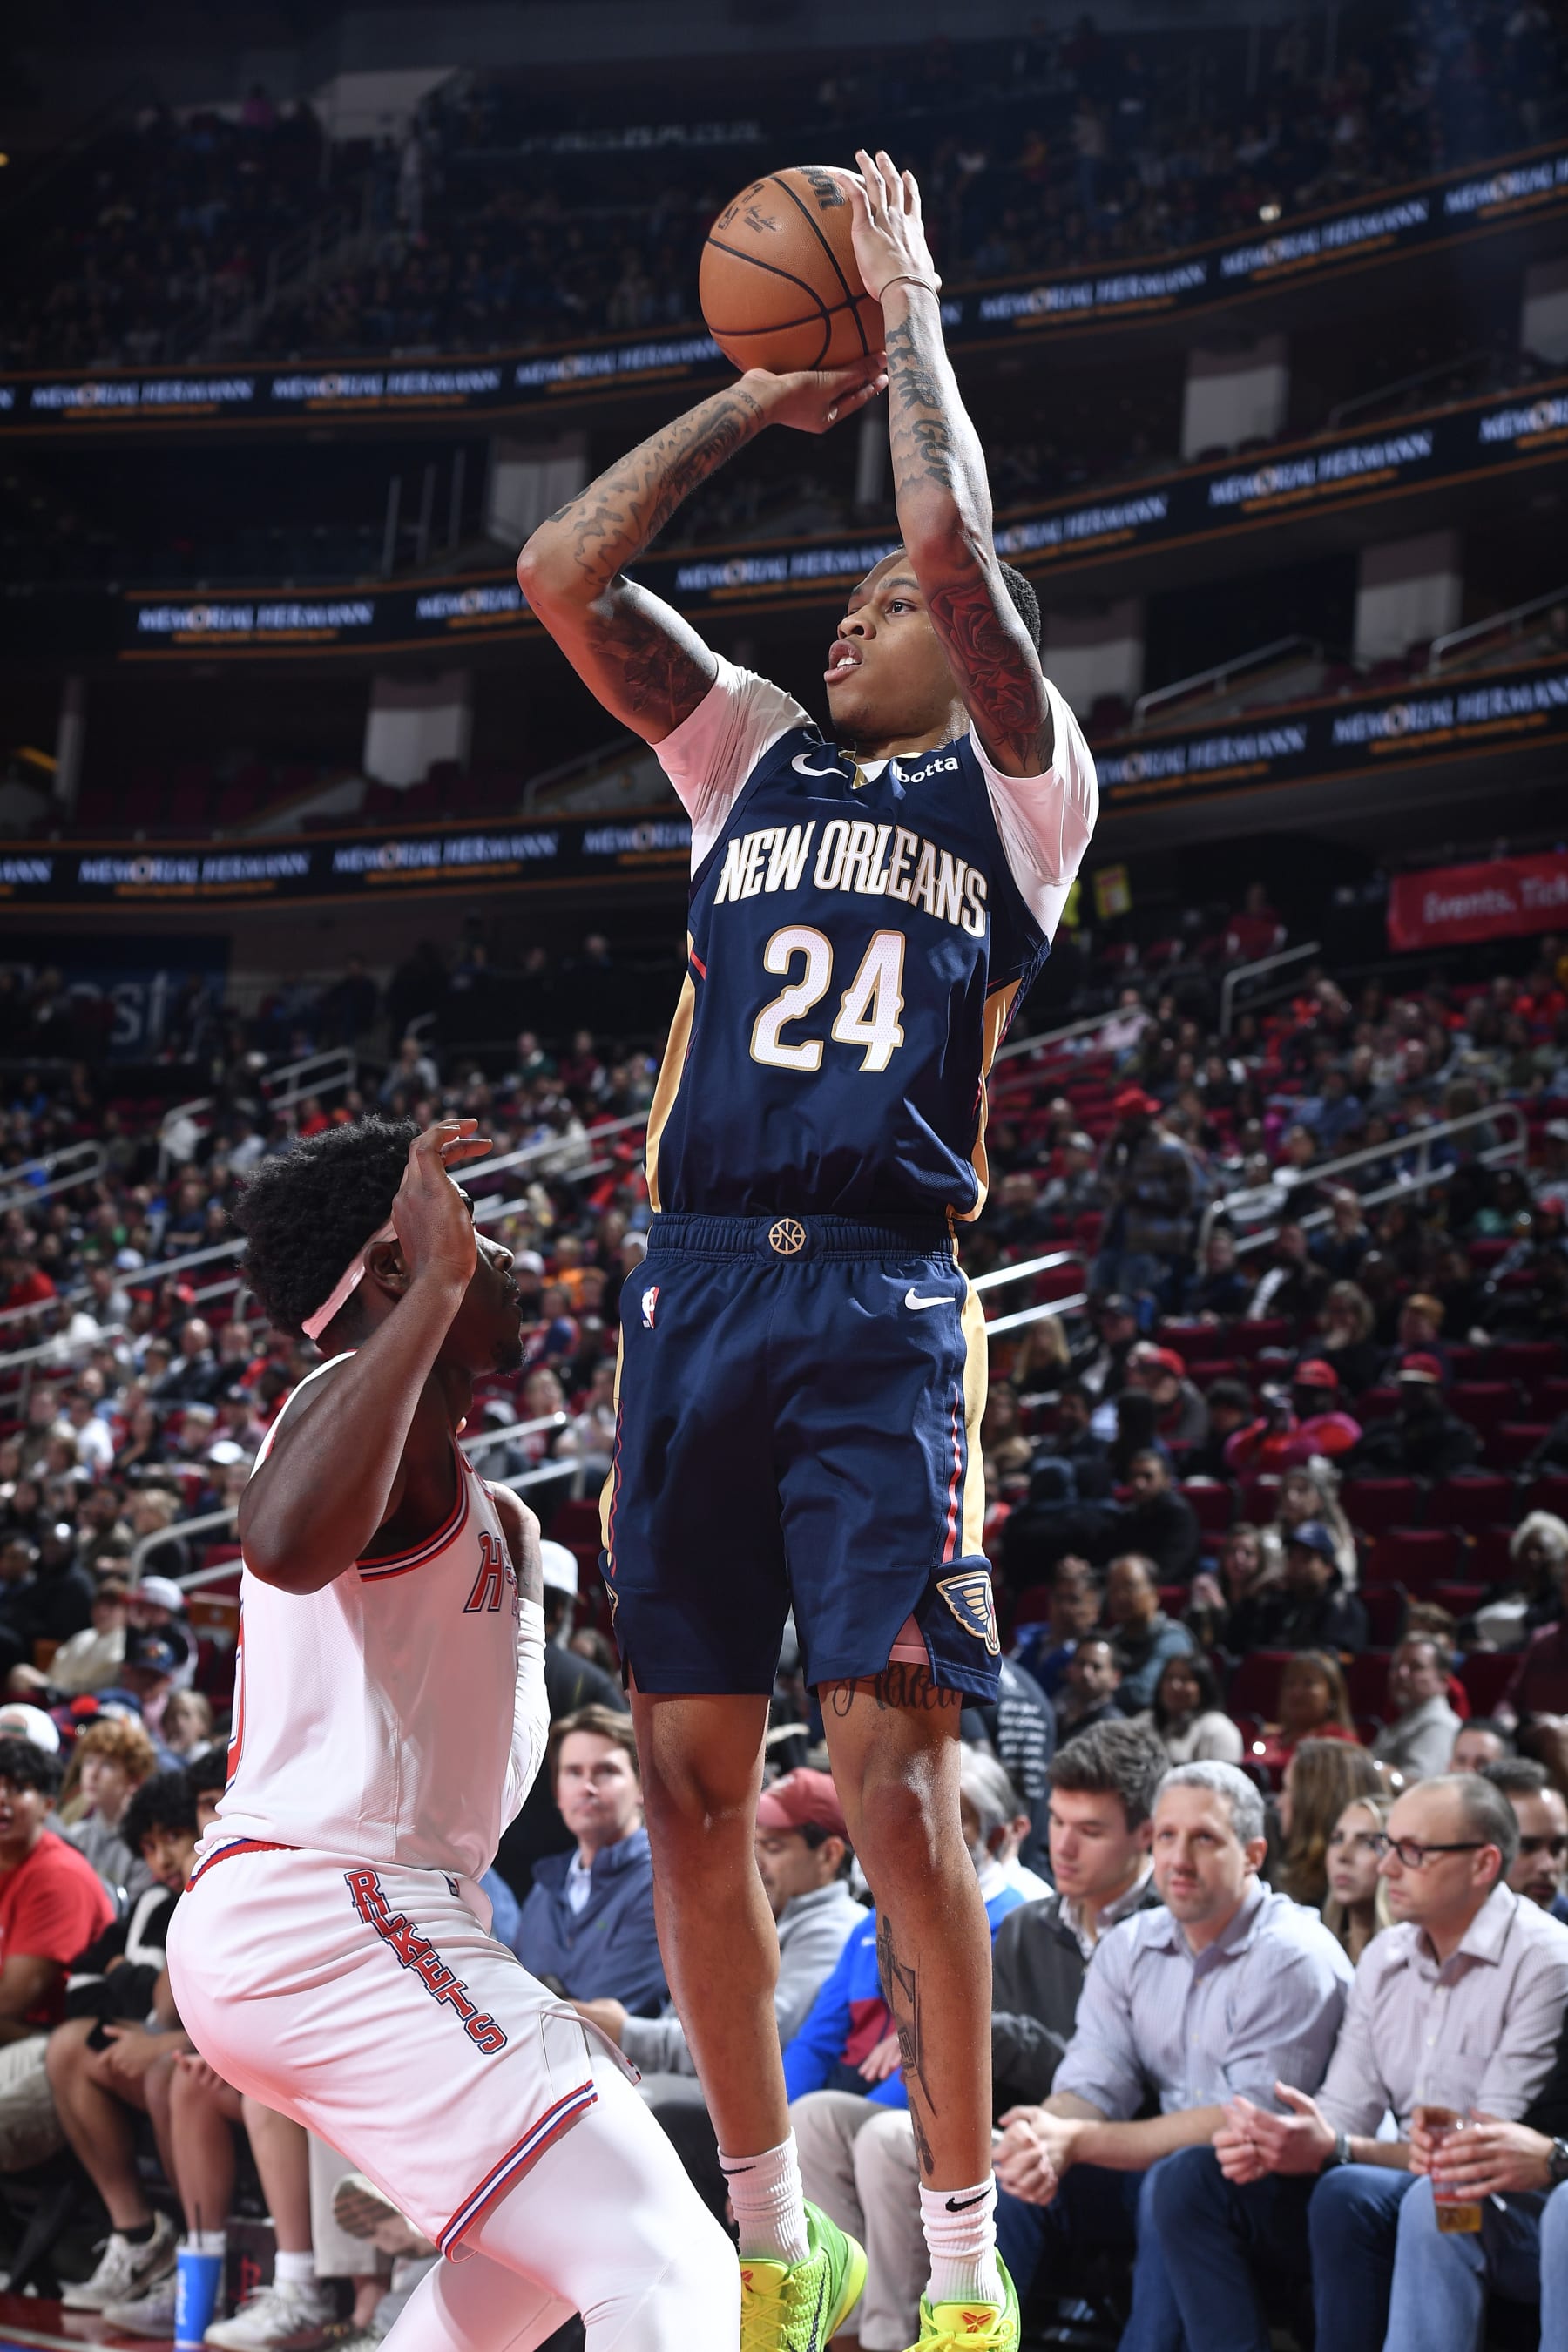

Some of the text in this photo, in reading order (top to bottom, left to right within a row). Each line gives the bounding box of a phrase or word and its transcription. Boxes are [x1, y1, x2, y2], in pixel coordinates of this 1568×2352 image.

[713, 819, 988, 938] NEW ORLEANS
[749, 924, 906, 1072] 24
